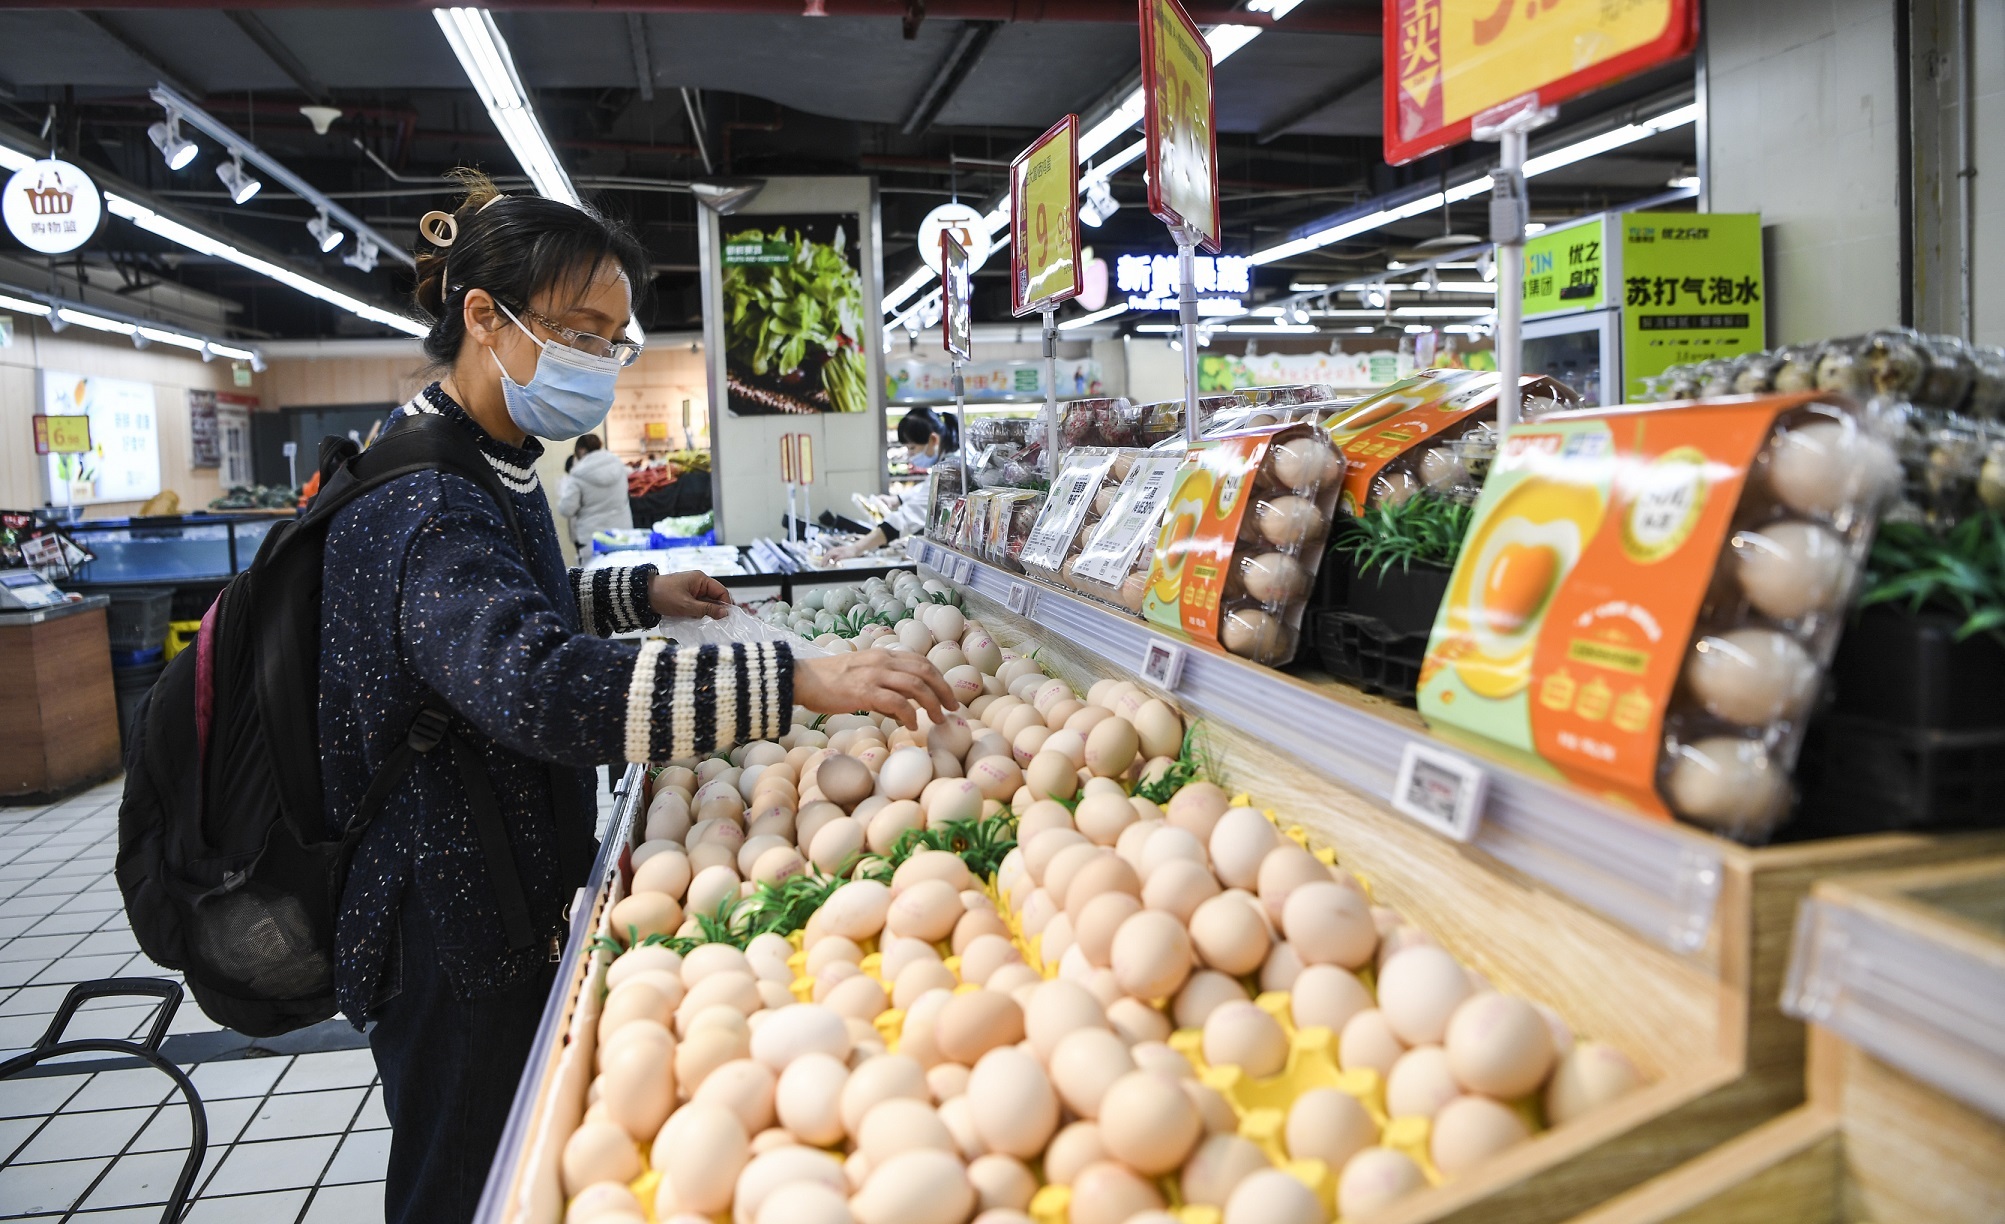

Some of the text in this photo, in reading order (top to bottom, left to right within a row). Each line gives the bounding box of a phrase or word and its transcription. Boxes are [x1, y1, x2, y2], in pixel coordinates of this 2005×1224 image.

[31, 220, 77, 234] 购物篮
[1626, 275, 1761, 307] 苏打气泡水
